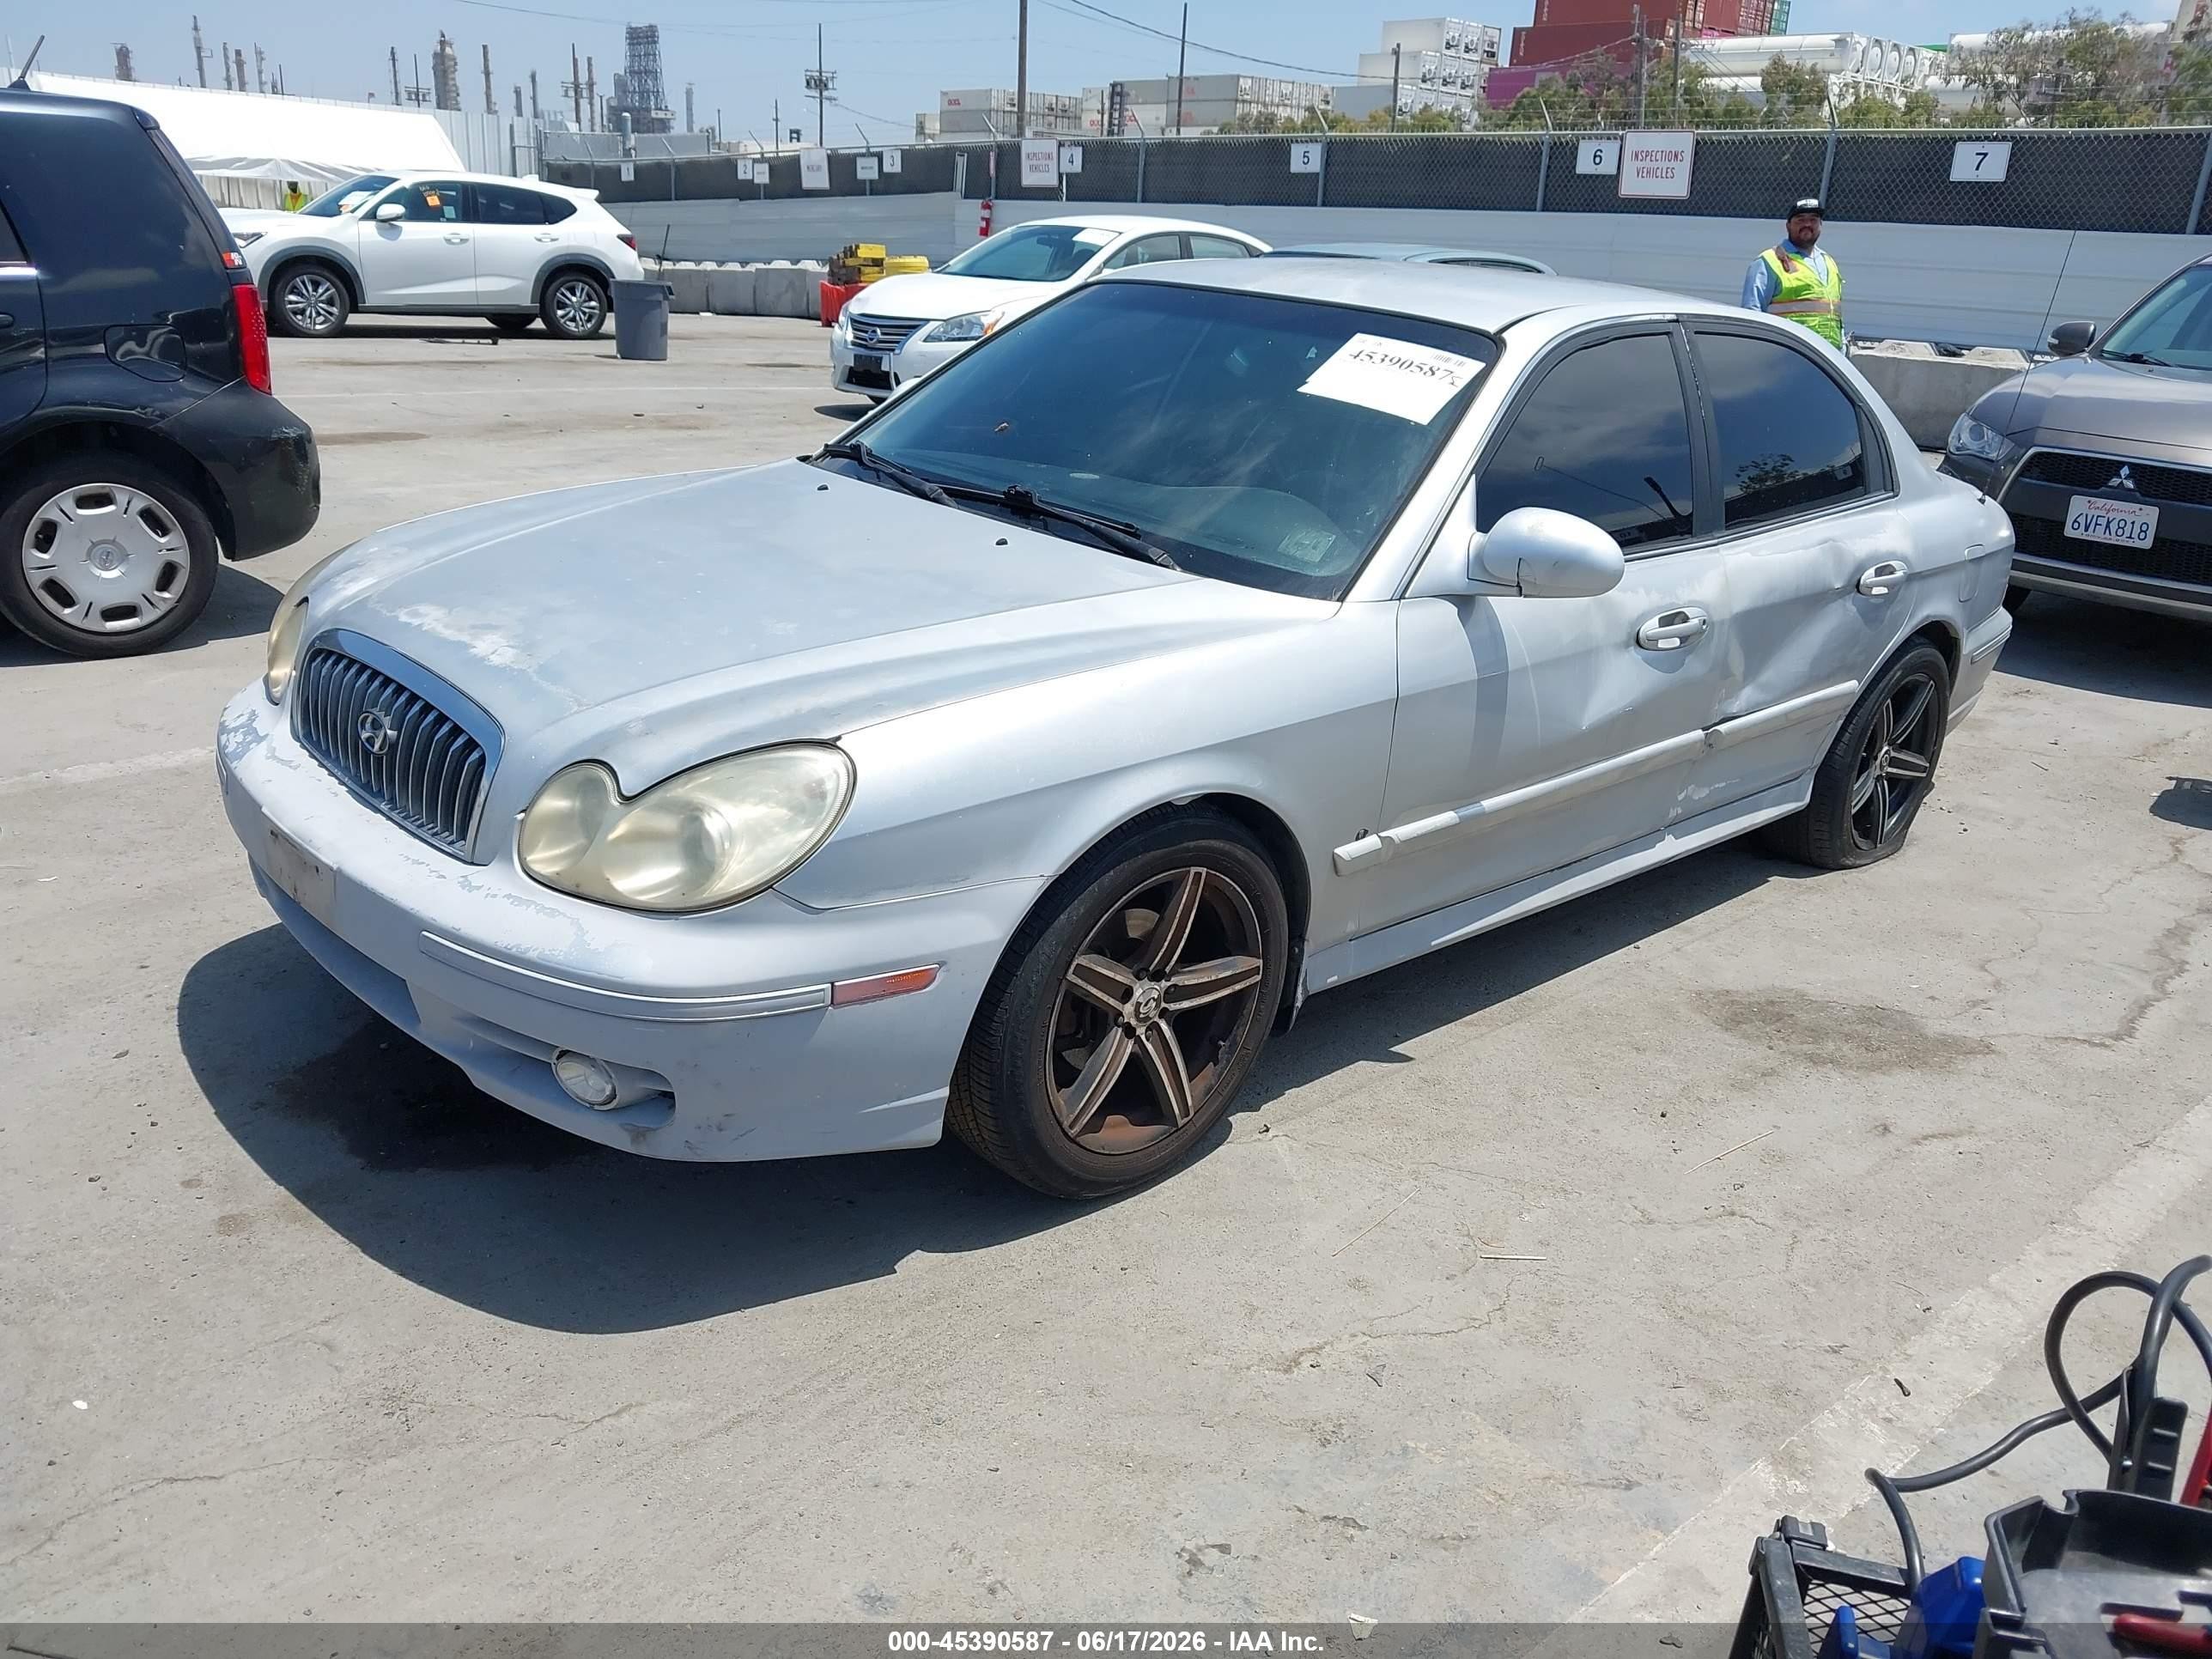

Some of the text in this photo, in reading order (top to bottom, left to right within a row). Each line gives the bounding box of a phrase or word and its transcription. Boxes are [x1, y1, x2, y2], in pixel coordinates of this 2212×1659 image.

[890, 155, 895, 167] 3
[1067, 153, 1074, 166] 4
[1302, 150, 1310, 165] 5
[1592, 149, 1604, 166] 6
[1631, 149, 1685, 163] INSPECTIONS
[1974, 151, 1989, 171] 7
[743, 163, 748, 175] 2
[1636, 167, 1675, 179] VEHICLES
[1349, 349, 1455, 380] 45390587
[2087, 501, 2142, 516] California
[2071, 513, 2149, 541] 6VFK818
